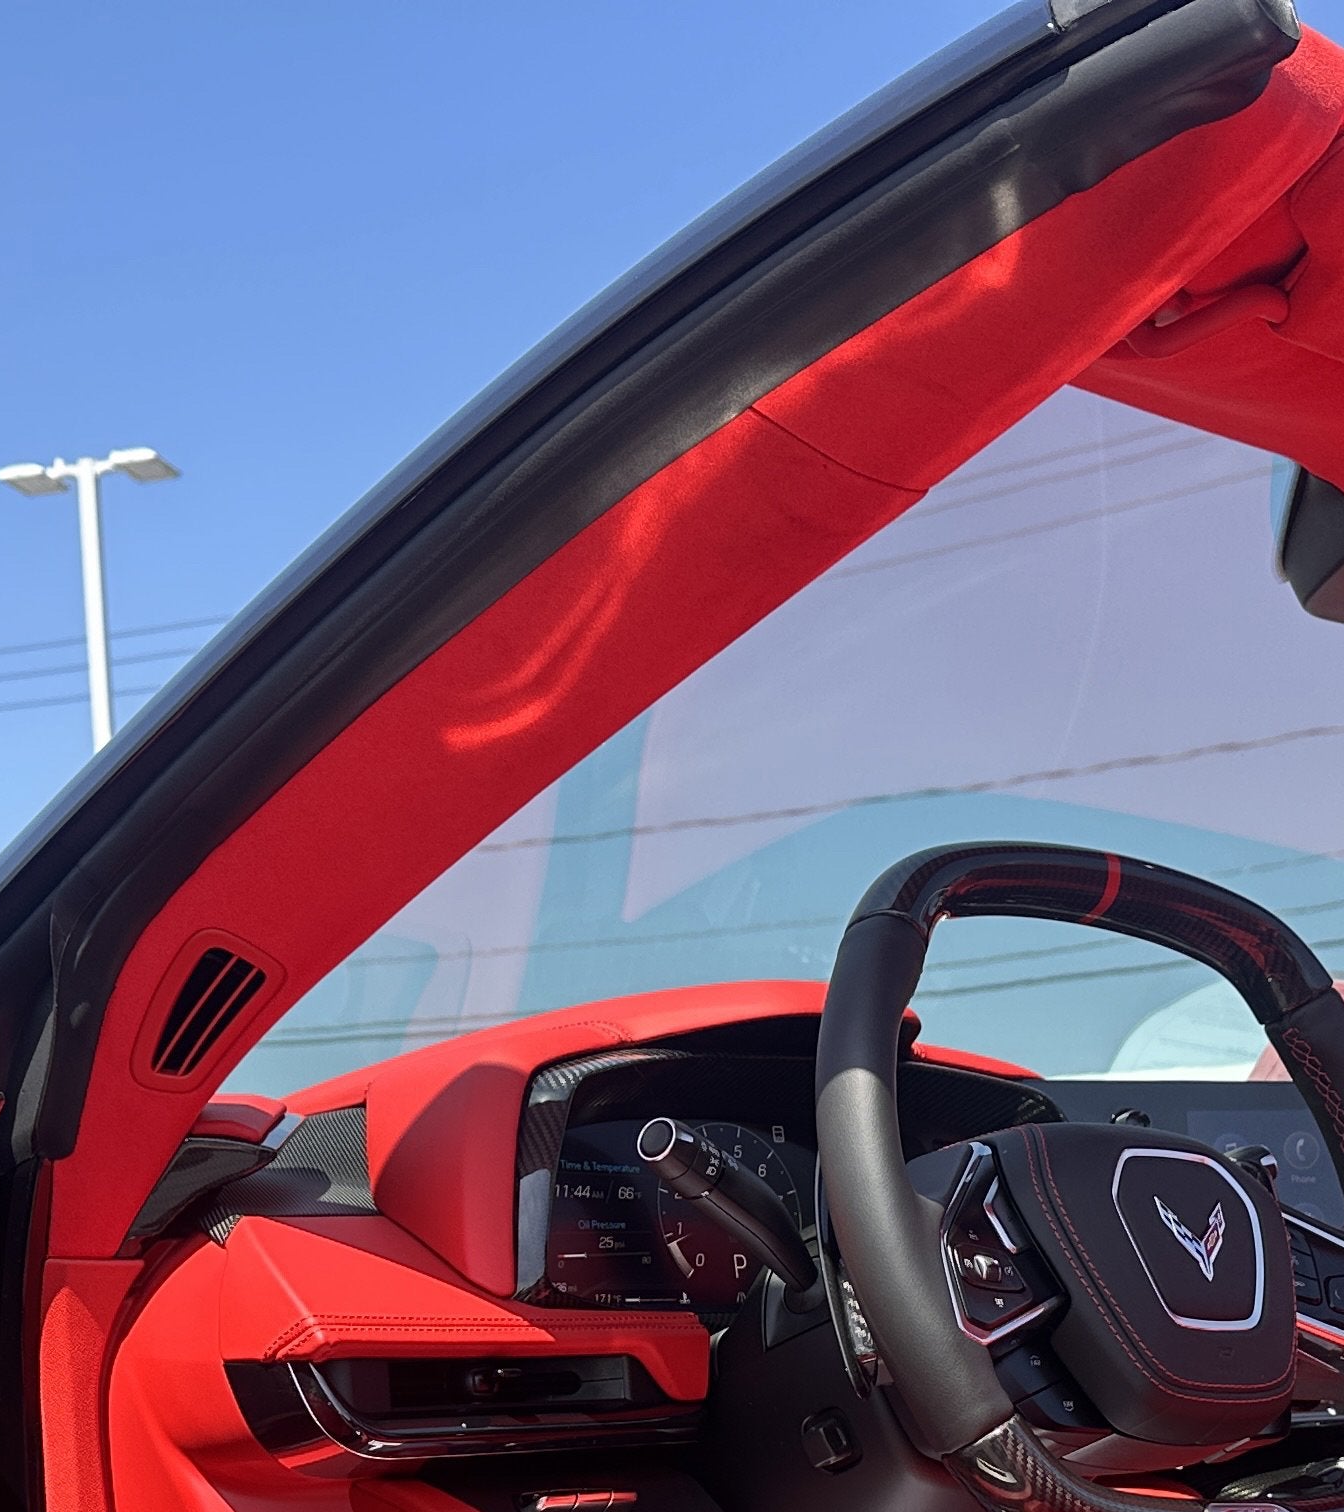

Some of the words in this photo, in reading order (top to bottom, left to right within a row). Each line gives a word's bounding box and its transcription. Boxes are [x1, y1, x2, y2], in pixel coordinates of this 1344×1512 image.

[733, 1145, 743, 1158] 5
[559, 1159, 582, 1170] Time
[593, 1162, 641, 1173] Temperature
[758, 1164, 767, 1177] 6
[1290, 1174, 1316, 1184] Phone
[555, 1184, 591, 1199] 11:44
[578, 1219, 590, 1229] Oil
[592, 1220, 627, 1230] Pressure
[695, 1253, 705, 1267] 0
[733, 1253, 748, 1279] P
